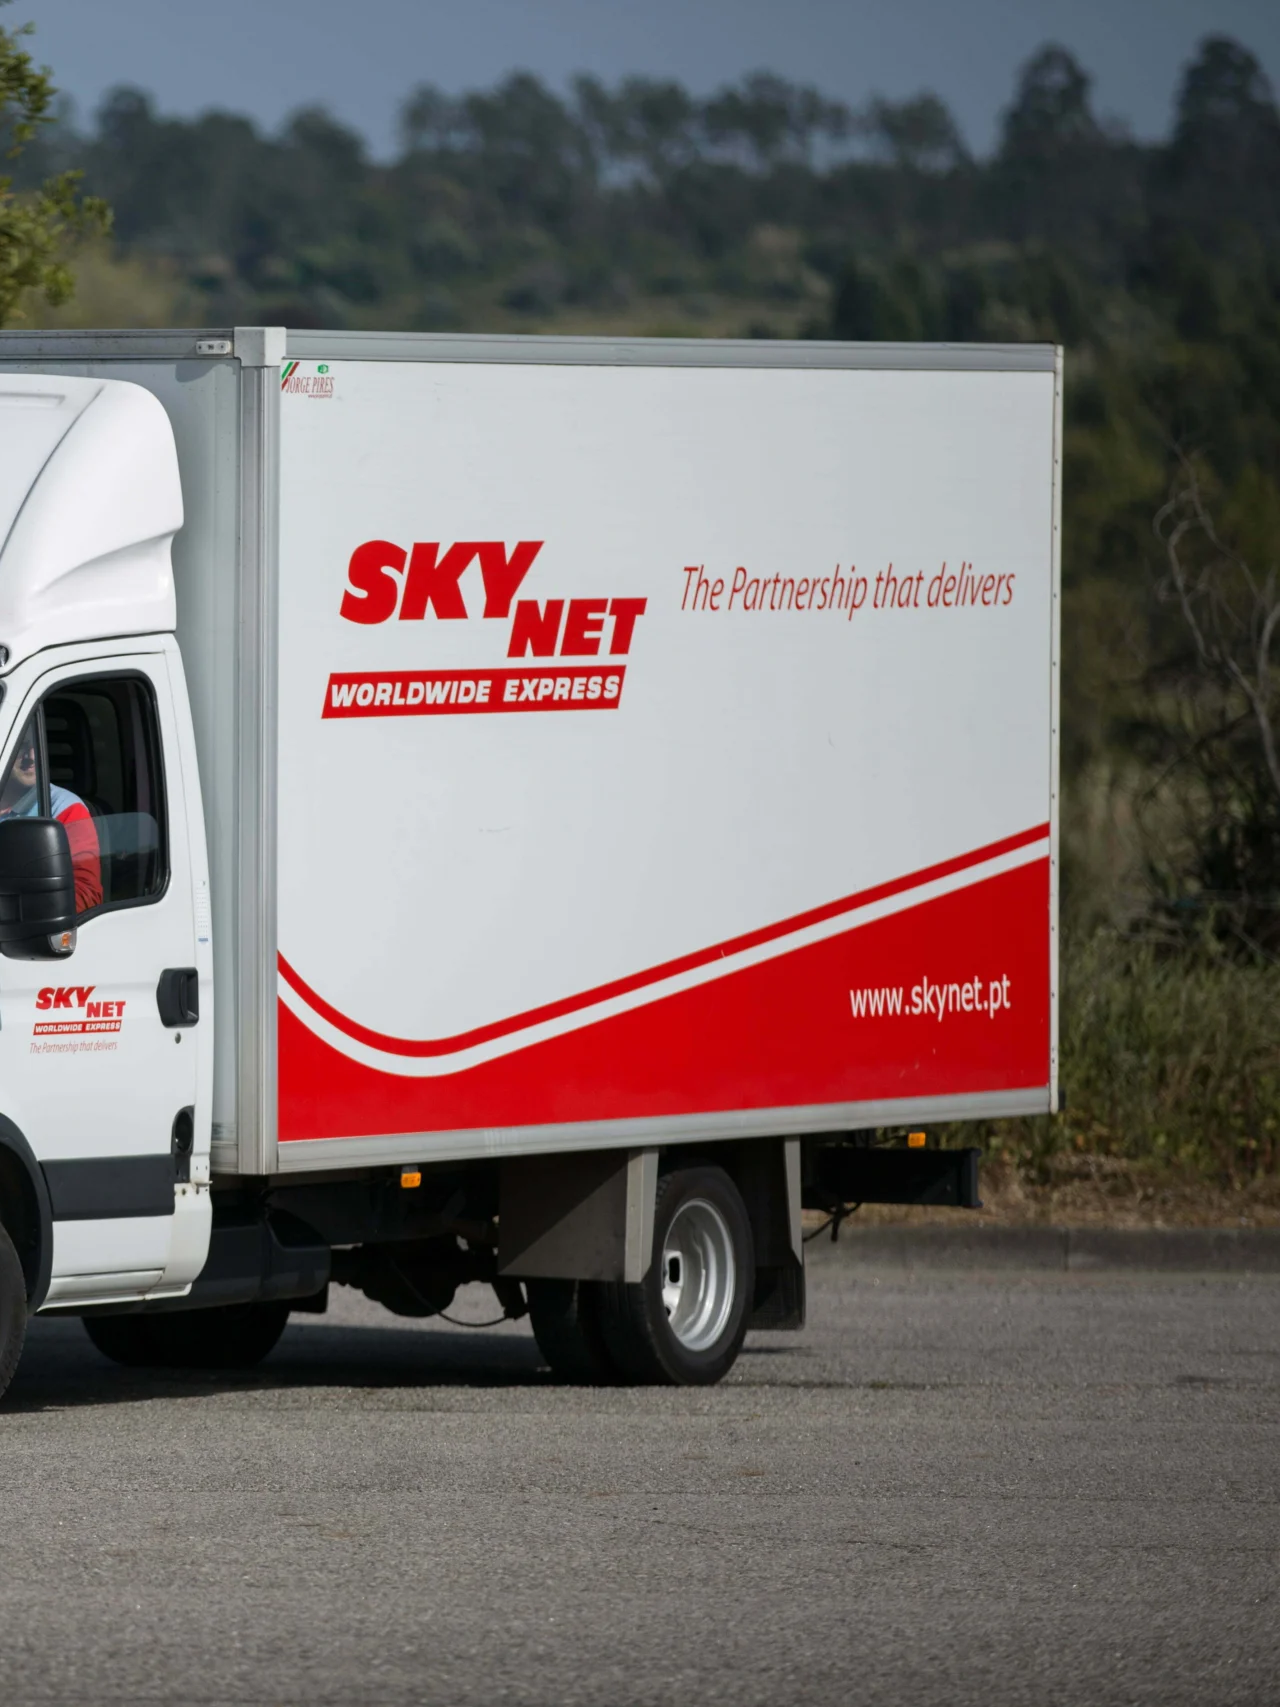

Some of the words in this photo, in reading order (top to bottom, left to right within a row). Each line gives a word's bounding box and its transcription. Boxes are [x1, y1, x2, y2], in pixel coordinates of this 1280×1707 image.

[312, 376, 334, 394] PIRES
[681, 563, 725, 611] The
[727, 563, 868, 622] Partnership
[872, 562, 925, 609] that
[926, 561, 1016, 608] delivers
[330, 679, 492, 708] WORLDWIDE
[502, 675, 621, 703] EXPRESS
[849, 973, 1012, 1023] www.skynet.pt
[35, 1023, 83, 1033] WORLDWIDE
[85, 1021, 121, 1032] EXPRESS
